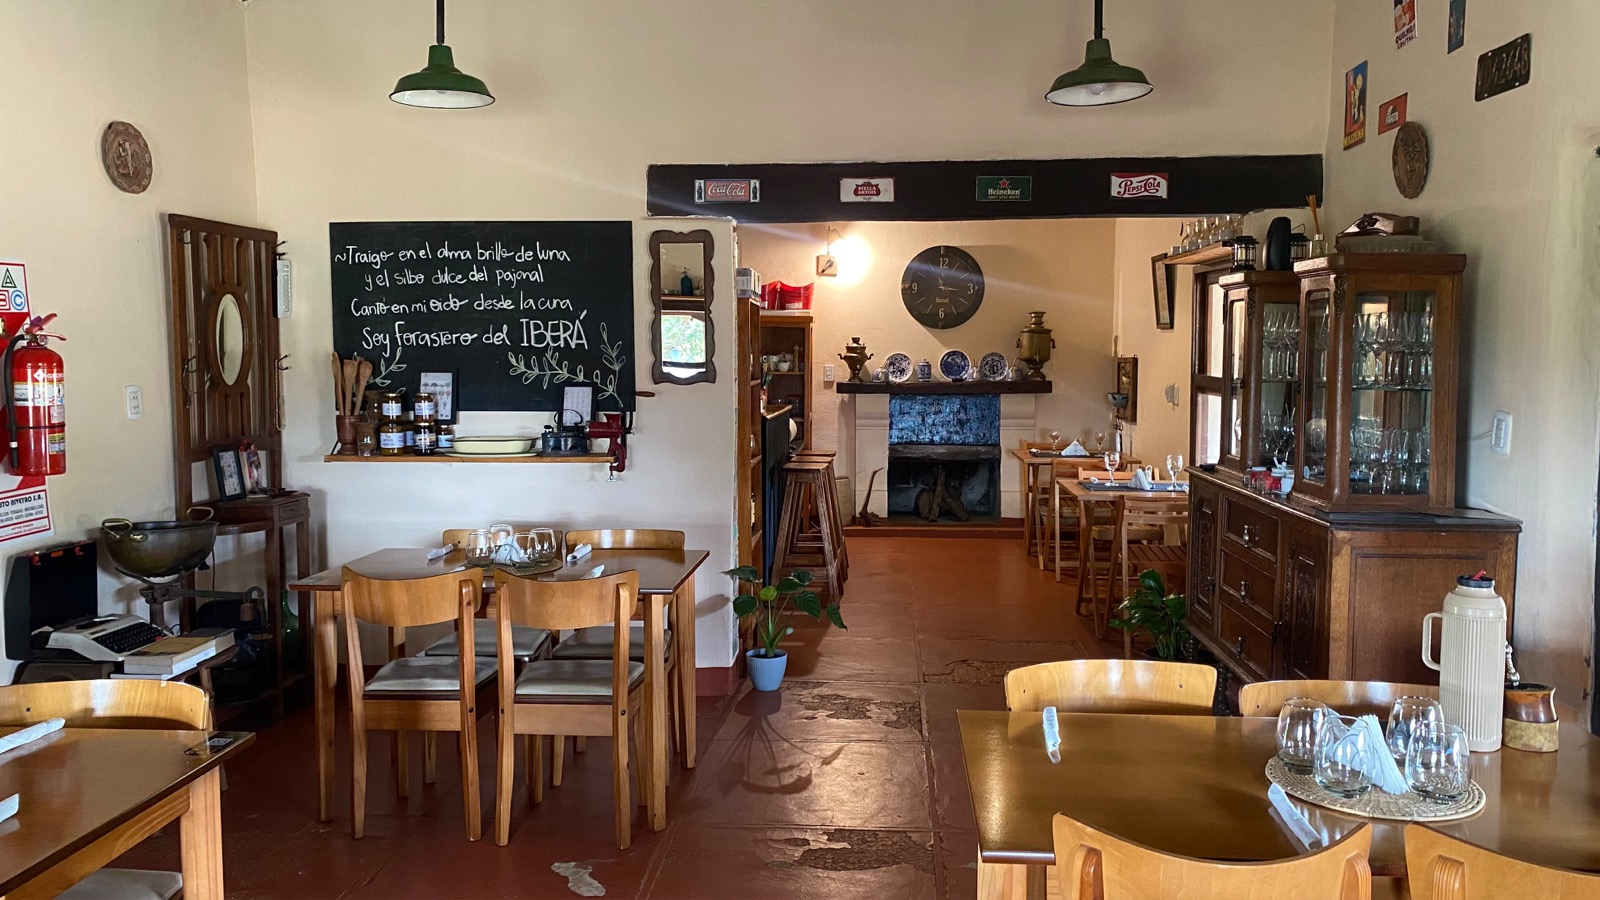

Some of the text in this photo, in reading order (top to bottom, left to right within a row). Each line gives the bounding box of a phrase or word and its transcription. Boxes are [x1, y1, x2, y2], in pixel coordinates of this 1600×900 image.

[399, 250, 416, 261] en
[420, 242, 431, 258] el
[438, 241, 472, 260] alma
[477, 241, 514, 261] brillo
[515, 246, 533, 262] de
[536, 241, 570, 261] luna
[940, 258, 949, 268] 12
[365, 264, 544, 291] y el silbo dulce del pajonal
[912, 283, 973, 294] 9 3
[14, 294, 23, 306] C
[391, 303, 409, 314] en
[412, 300, 426, 313] mi
[474, 293, 515, 310] desde
[521, 291, 535, 310] la
[538, 298, 573, 310] cuna
[939, 308, 944, 318] 6
[362, 327, 390, 357] Soy
[483, 324, 511, 345] del
[520, 309, 587, 349] IBERÁ
